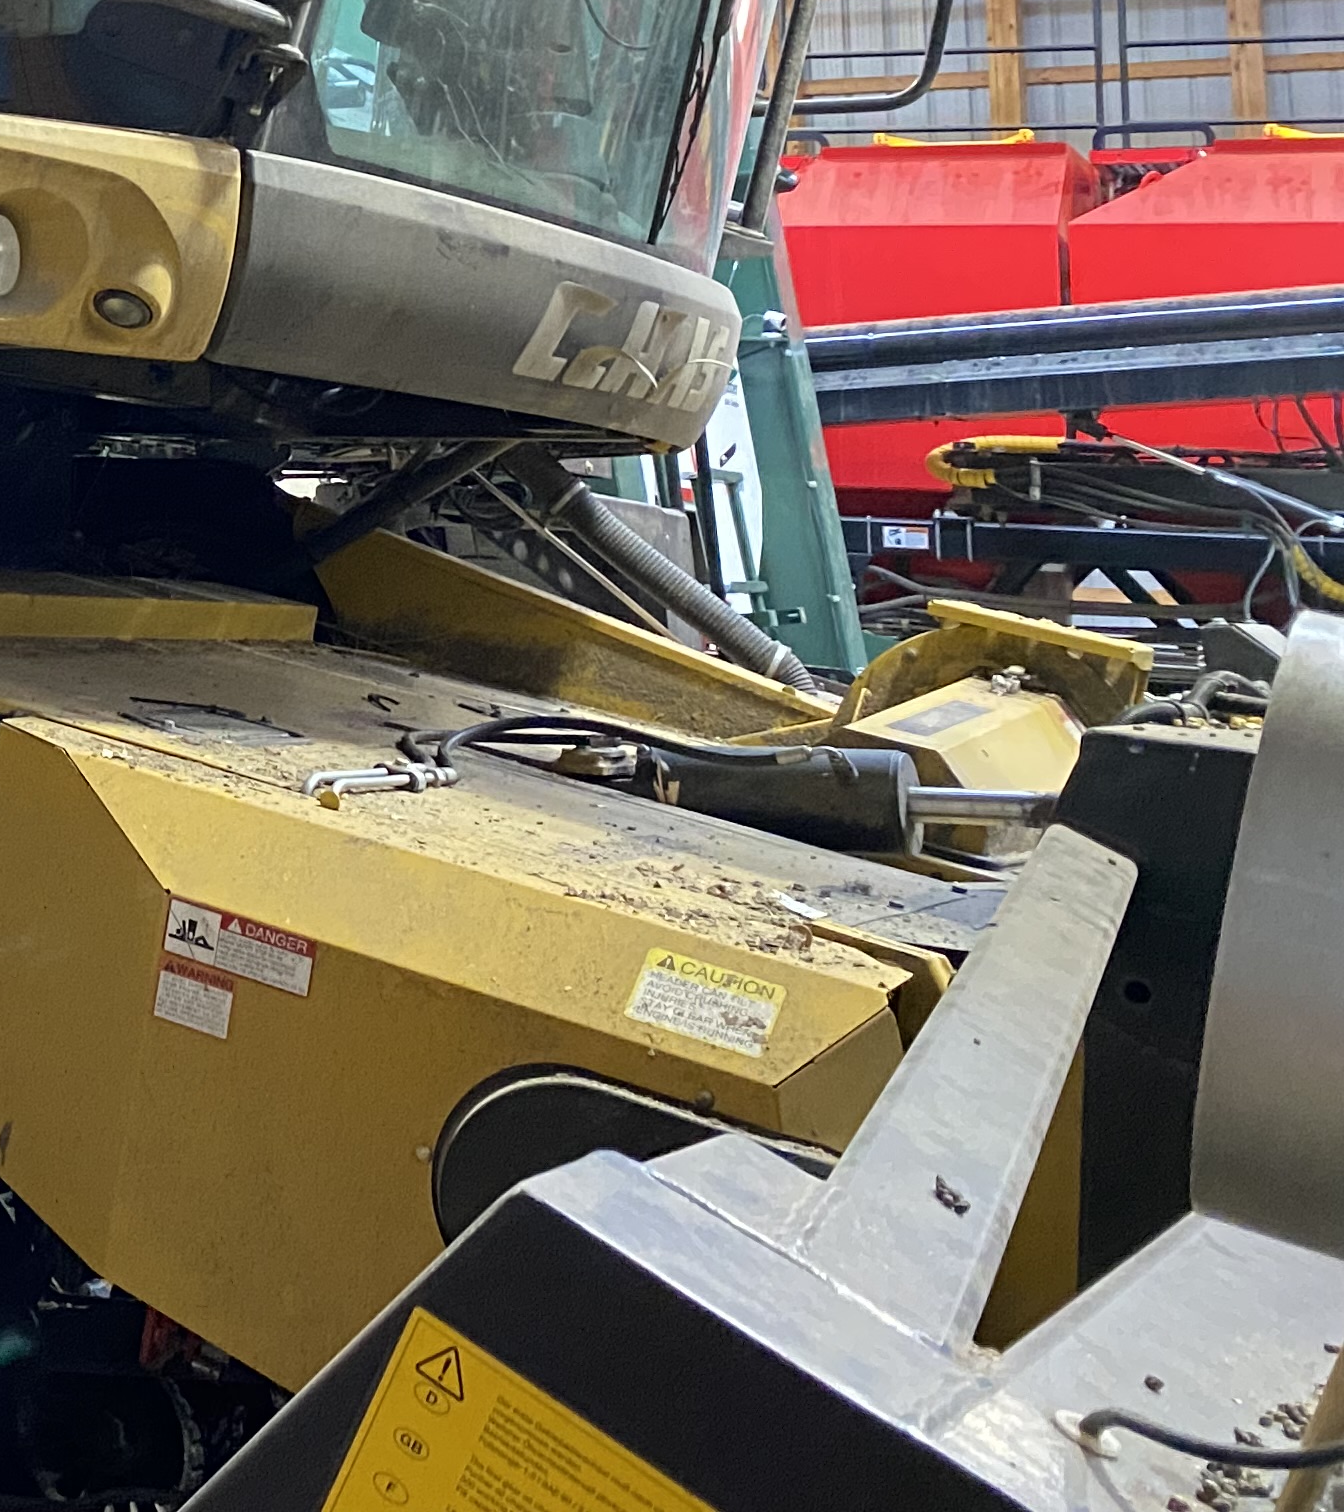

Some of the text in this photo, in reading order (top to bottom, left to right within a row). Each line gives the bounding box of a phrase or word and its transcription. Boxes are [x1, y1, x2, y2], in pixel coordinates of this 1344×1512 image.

[245, 923, 308, 955] DANGER
[176, 961, 234, 992] WARNING
[646, 979, 685, 996] AVOID
[701, 986, 727, 1000] CAN
[425, 1390, 438, 1406] D
[400, 1433, 423, 1455] GB
